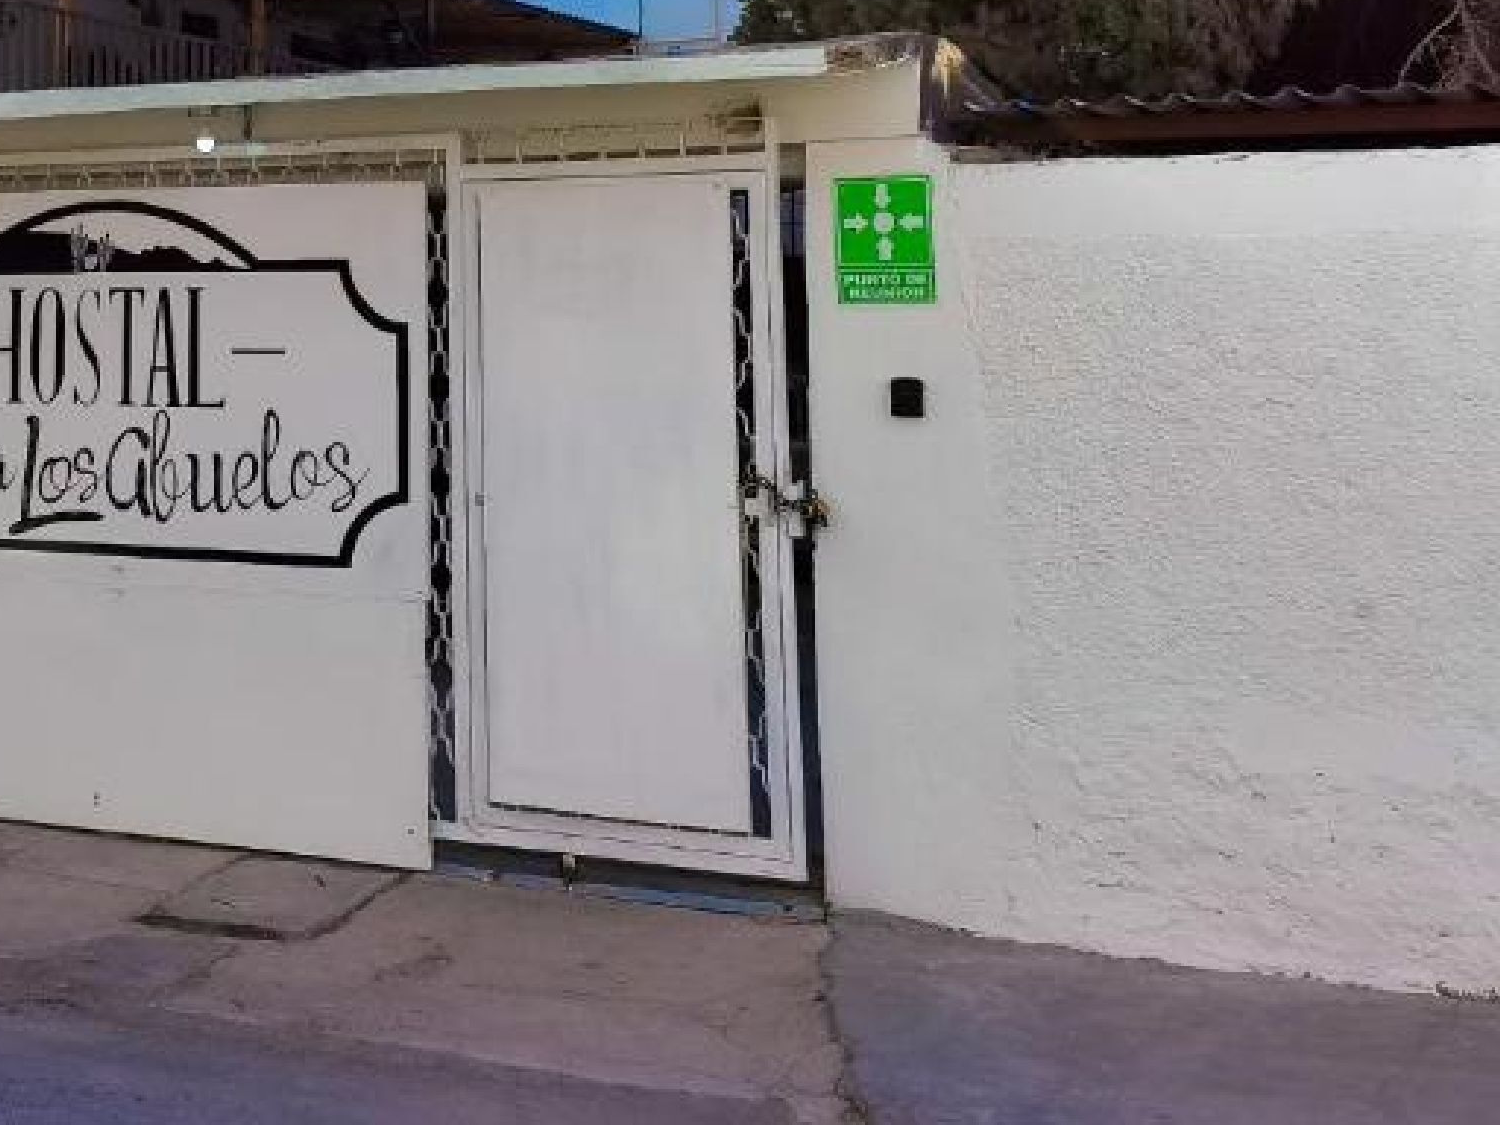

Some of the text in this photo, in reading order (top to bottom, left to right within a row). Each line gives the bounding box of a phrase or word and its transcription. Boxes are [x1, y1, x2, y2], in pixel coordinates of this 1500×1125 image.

[843, 274, 927, 285] PUNTO DE
[8, 415, 104, 535] Los
